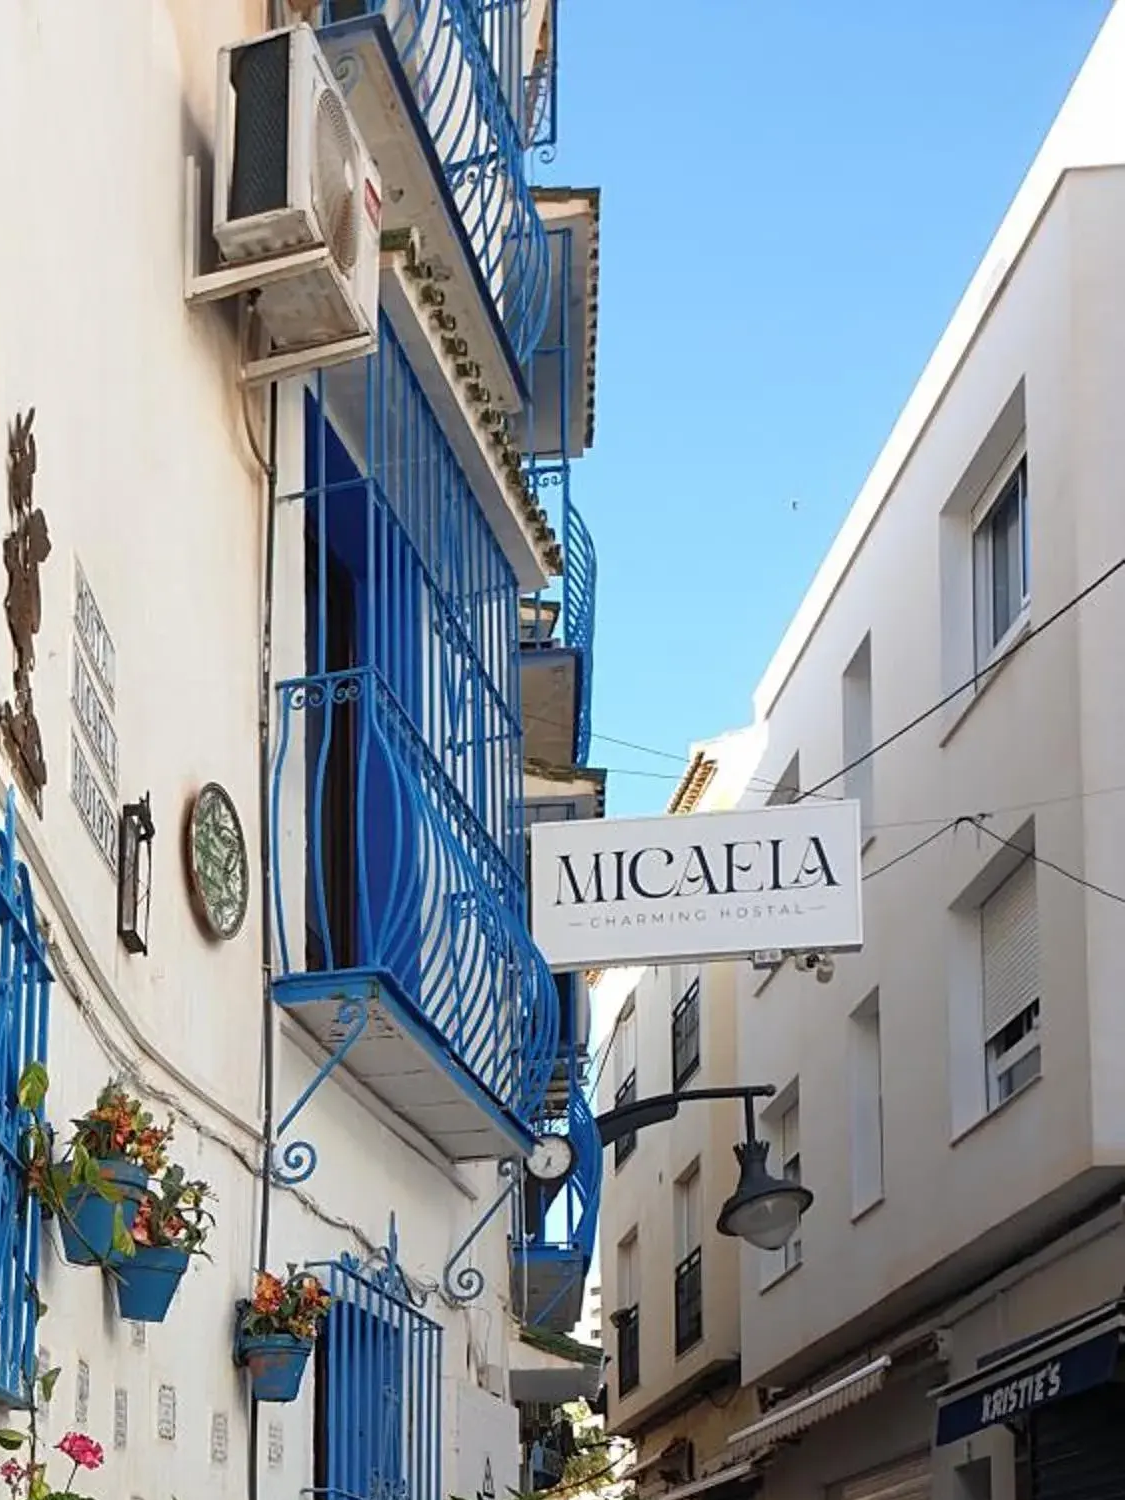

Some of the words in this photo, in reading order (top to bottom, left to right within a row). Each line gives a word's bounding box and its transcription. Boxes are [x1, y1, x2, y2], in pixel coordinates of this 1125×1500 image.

[554, 834, 843, 906] MICAELA
[590, 909, 708, 930] CHARMING
[720, 903, 807, 920] HOSTAL
[981, 1361, 1061, 1424] KRISTIE'S
